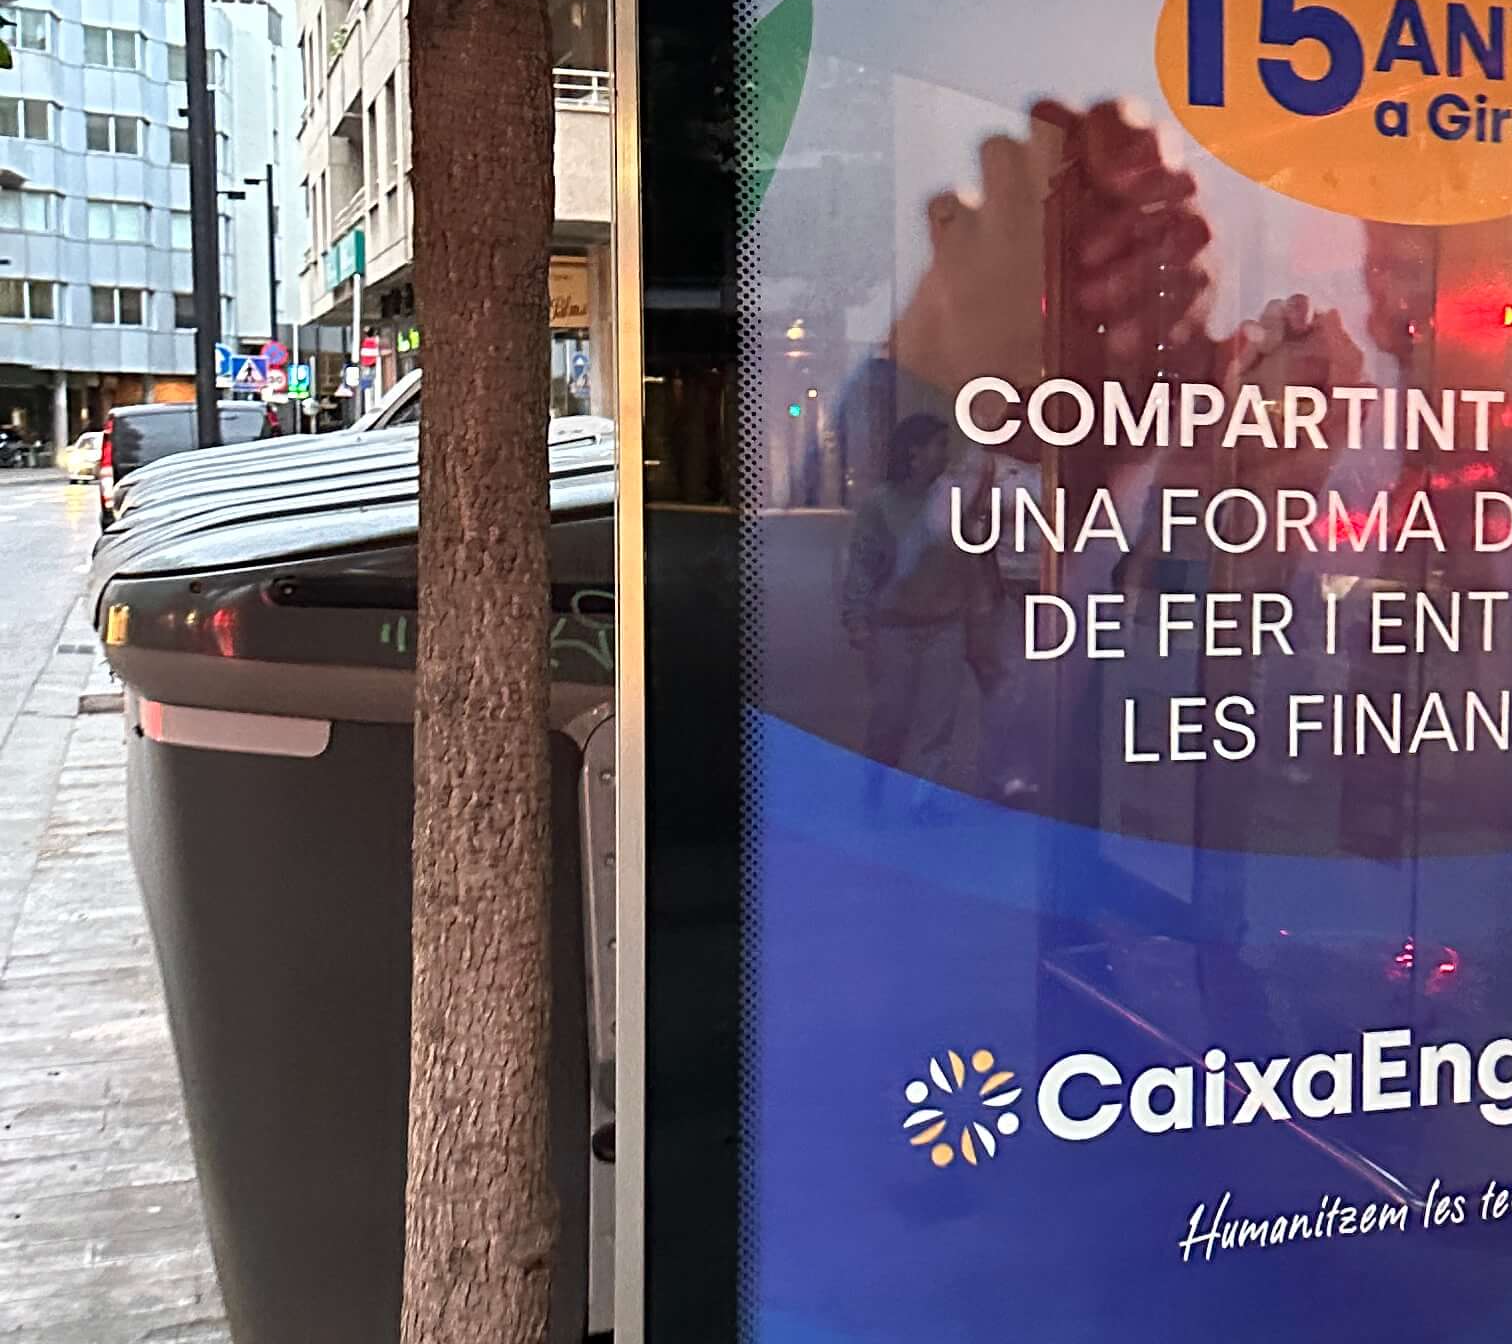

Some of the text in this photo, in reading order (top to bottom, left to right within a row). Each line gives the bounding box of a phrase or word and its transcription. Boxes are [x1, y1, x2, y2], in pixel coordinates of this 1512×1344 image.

[1374, 99, 1409, 138] a
[953, 375, 1506, 451] COMPARTINT
[948, 486, 1130, 555] UNA
[1161, 487, 1446, 555] FORMA
[1024, 592, 1125, 660] DE
[1159, 591, 1294, 658] FER
[1324, 590, 1338, 655] I
[1123, 694, 1258, 764] LES
[1178, 1191, 1409, 1262] Humanitzem
[1422, 1178, 1466, 1228] les
